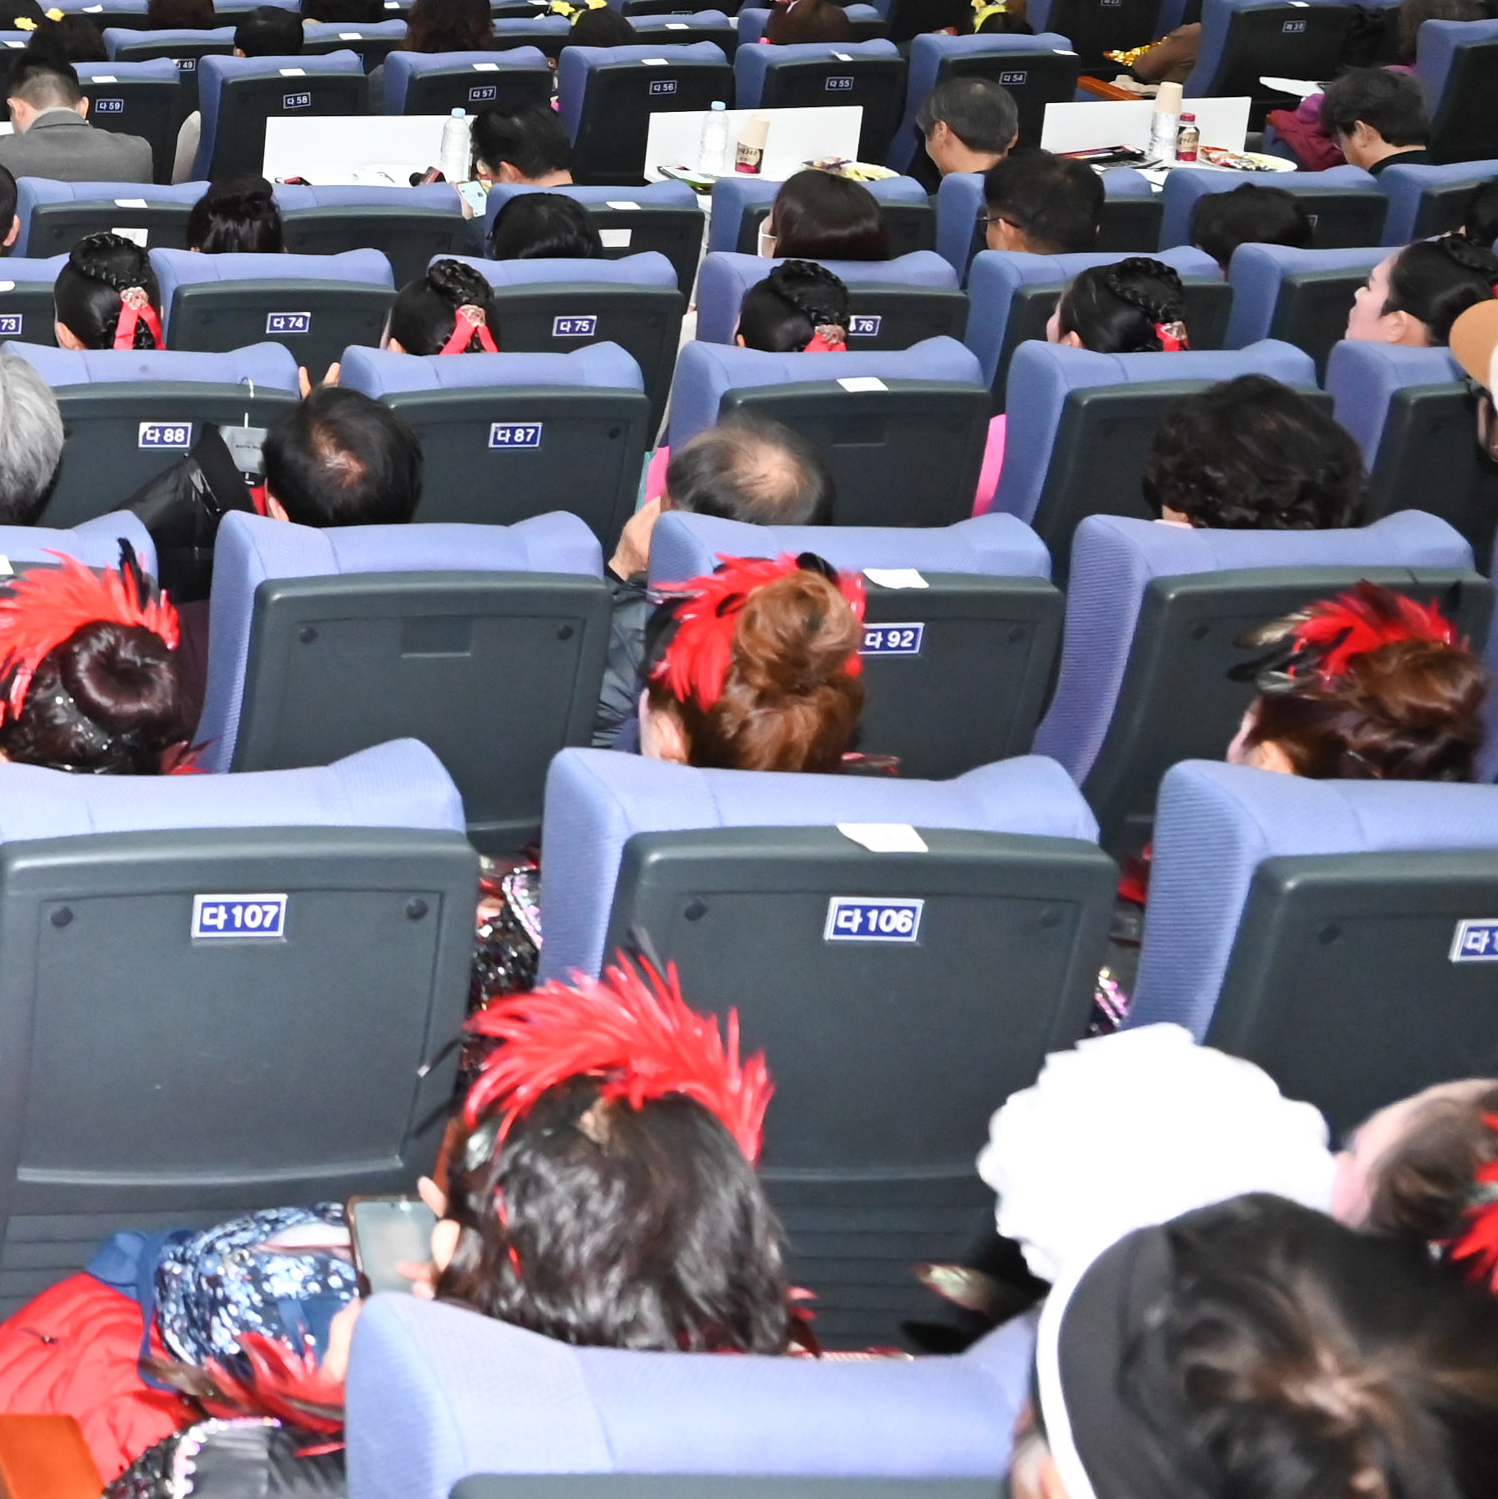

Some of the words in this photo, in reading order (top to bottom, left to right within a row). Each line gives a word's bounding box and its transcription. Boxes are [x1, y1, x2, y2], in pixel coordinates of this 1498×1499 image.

[0, 318, 16, 330] 73
[287, 316, 304, 329] 74
[573, 319, 590, 332] 75
[858, 320, 874, 332] 76
[163, 428, 185, 443] 88
[496, 428, 511, 443] 다
[513, 427, 535, 442] 87
[886, 629, 914, 648] 92
